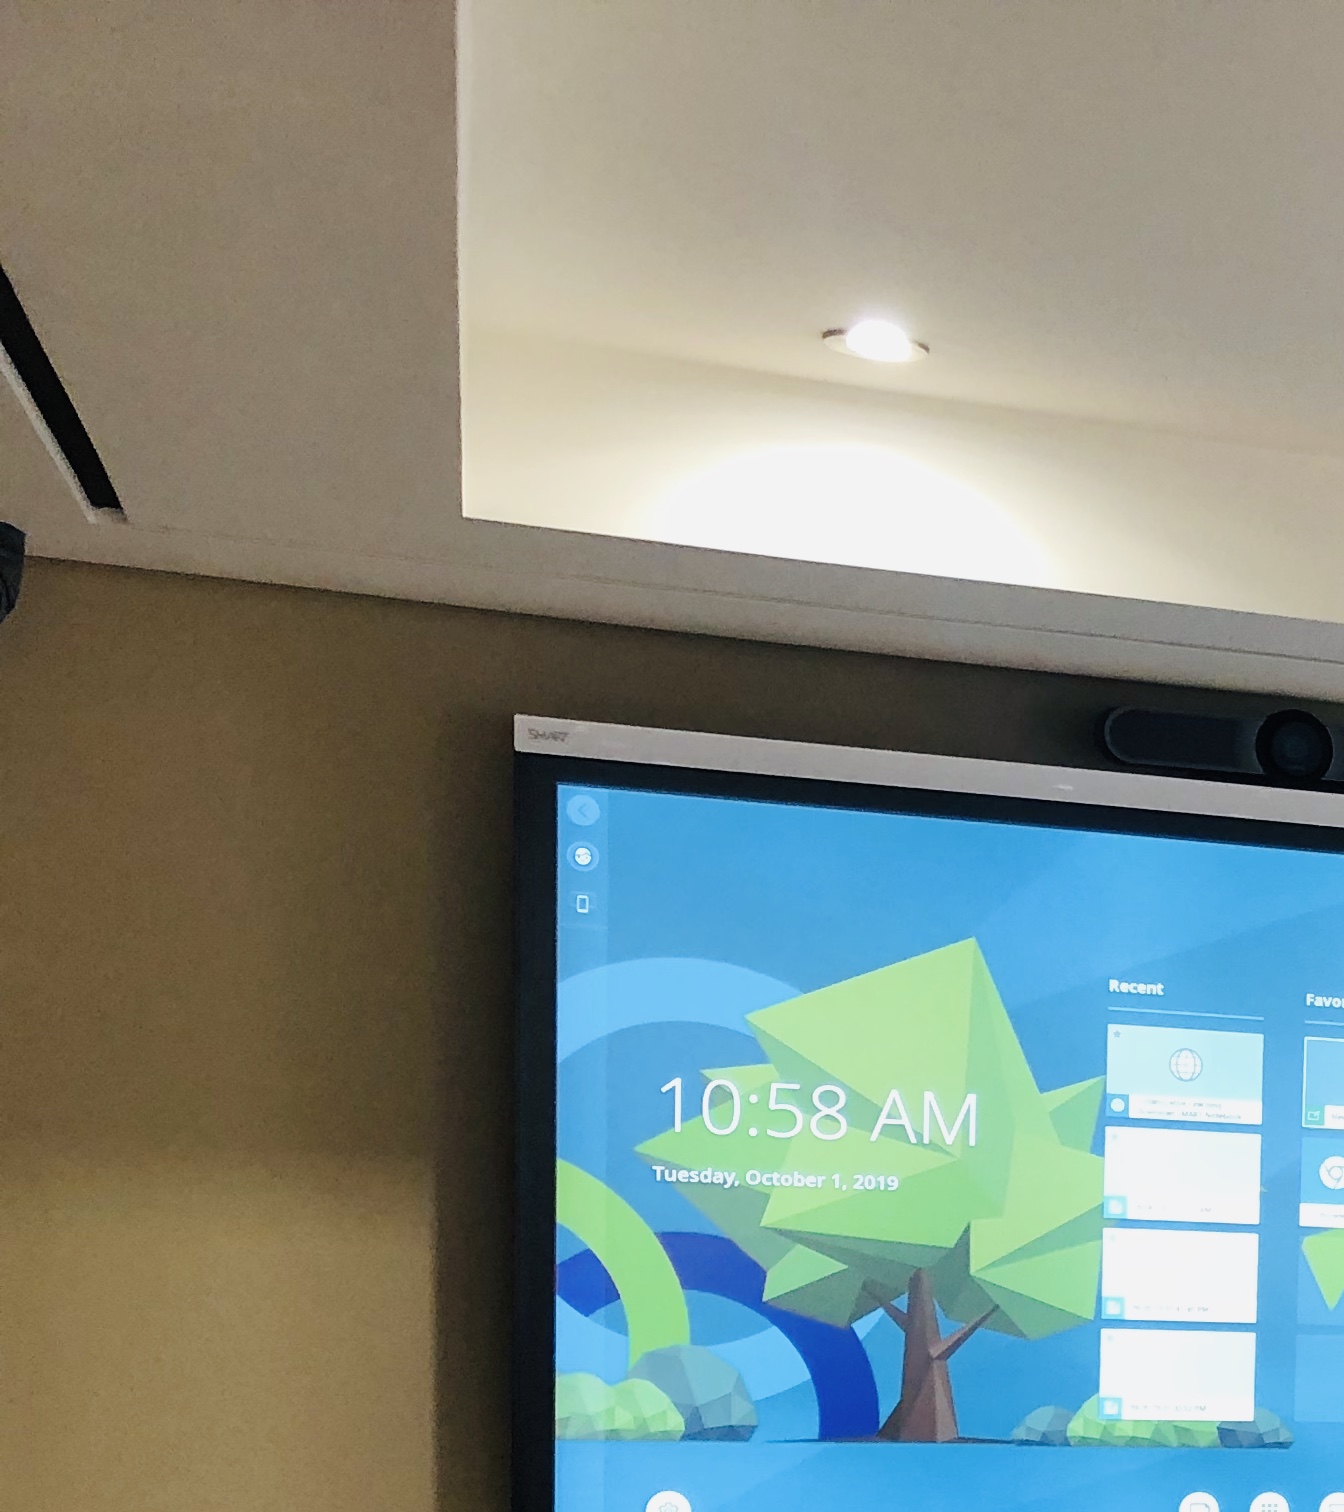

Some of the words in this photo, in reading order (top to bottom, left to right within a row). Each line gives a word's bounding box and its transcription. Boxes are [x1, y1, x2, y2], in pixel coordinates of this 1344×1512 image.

[1108, 979, 1165, 996] Recent
[660, 1077, 848, 1141] 10:58
[869, 1089, 978, 1147] AM
[652, 1165, 740, 1189] Tuesday,
[745, 1169, 826, 1188] October
[831, 1173, 847, 1191] 1,
[852, 1174, 899, 1191] 2019
